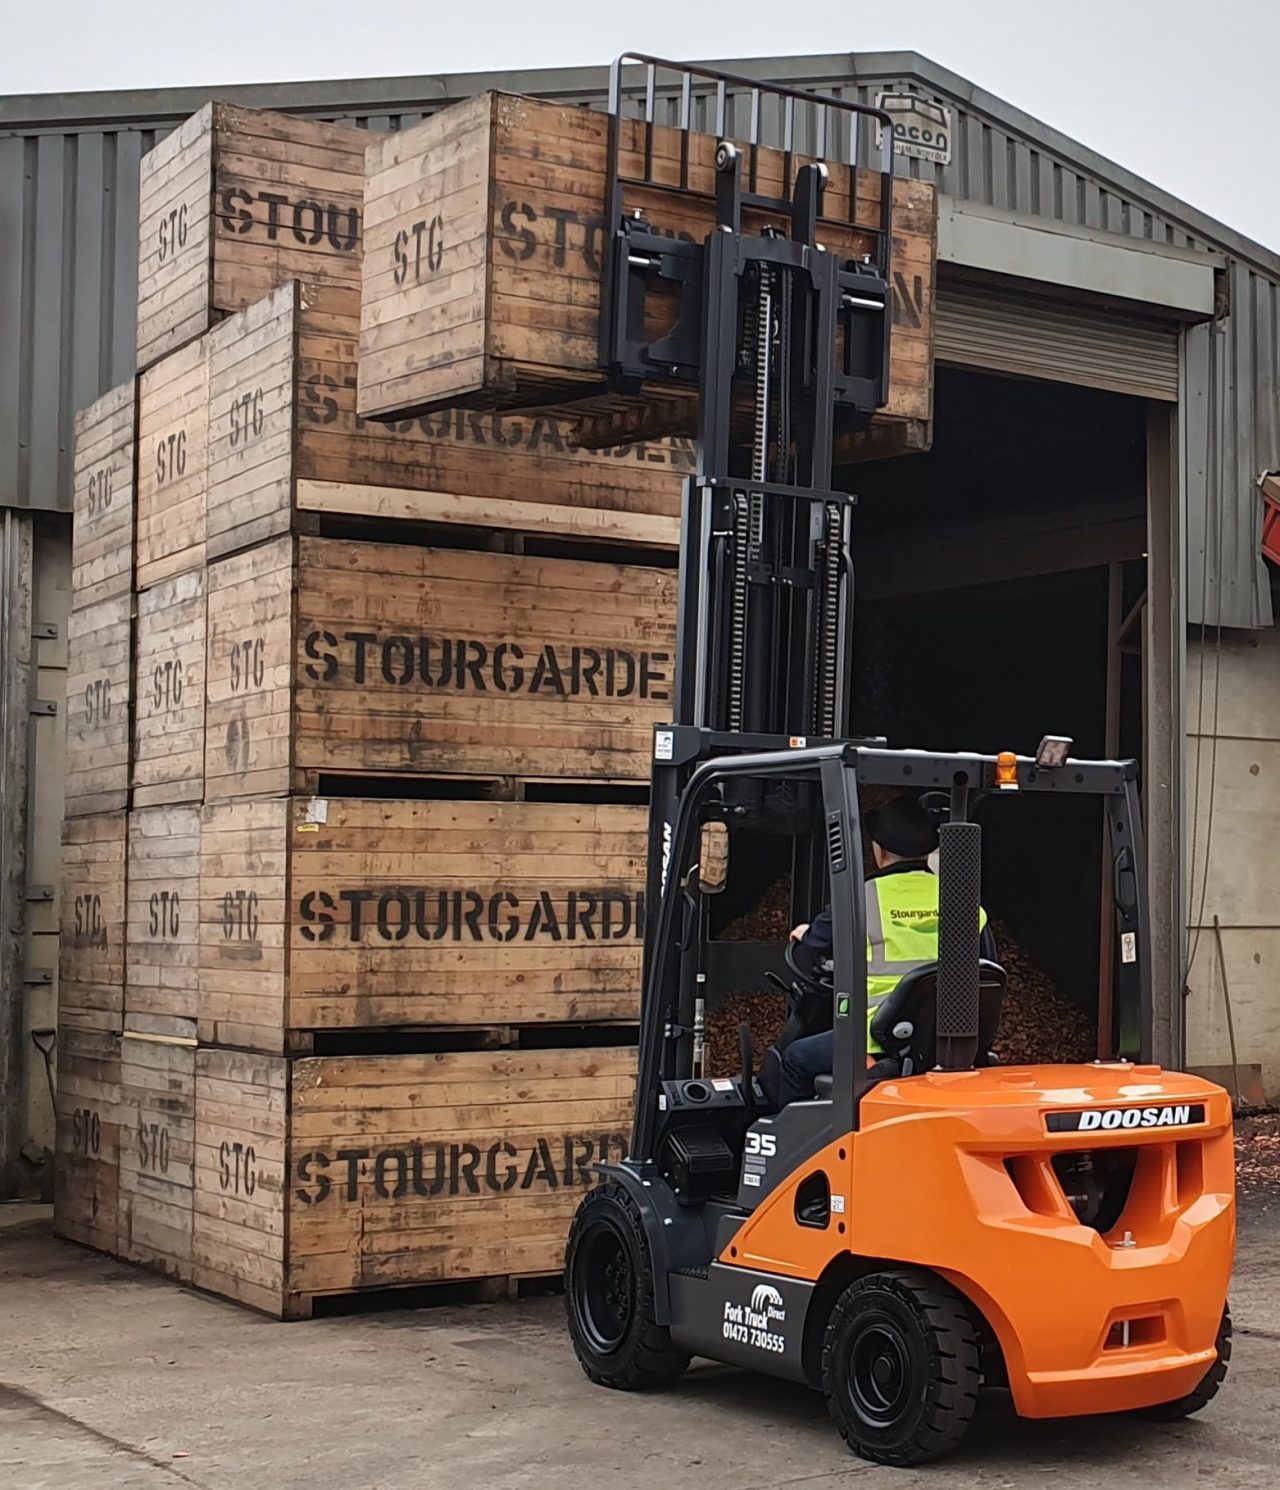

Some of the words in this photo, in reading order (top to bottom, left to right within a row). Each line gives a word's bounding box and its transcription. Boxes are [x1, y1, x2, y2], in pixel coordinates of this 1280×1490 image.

[893, 123, 948, 152] acon
[159, 202, 188, 262] STG
[393, 215, 443, 286] STG
[230, 387, 264, 447] STG
[157, 429, 186, 484] STG
[88, 465, 112, 517] STG
[154, 659, 182, 710] STG
[230, 637, 264, 692] STG
[304, 629, 677, 700] STOURGARDE
[85, 678, 111, 724] STG
[74, 894, 101, 937] STG
[150, 891, 179, 938] STG
[223, 890, 258, 941] STG
[73, 1108, 100, 1154] STG
[1078, 1106, 1190, 1130] DOOSAN
[139, 1123, 169, 1174] STG
[219, 1141, 256, 1196] STG
[745, 1132, 777, 1157] 35
[723, 1321, 748, 1343] 01473
[750, 1328, 785, 1353] 730555
[724, 1301, 743, 1323] Fork
[744, 1306, 768, 1330] Truck
[767, 1305, 785, 1321] Direct
